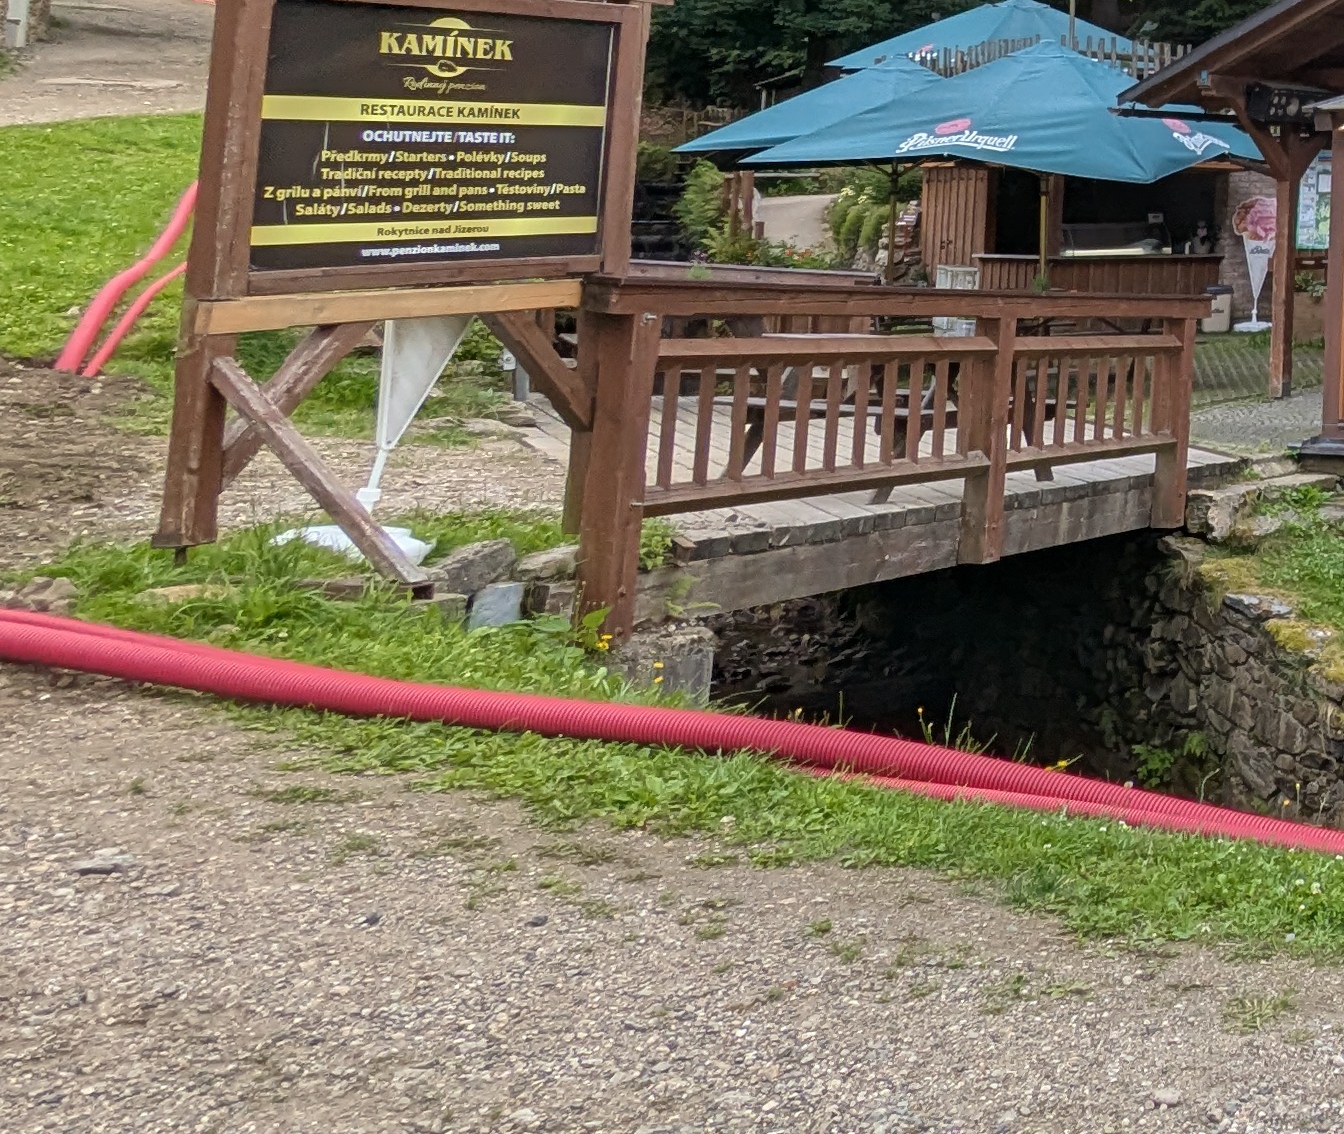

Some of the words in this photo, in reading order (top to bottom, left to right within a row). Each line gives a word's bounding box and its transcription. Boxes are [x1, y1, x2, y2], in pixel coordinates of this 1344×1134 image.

[379, 30, 514, 61] KAMÍNEK
[360, 104, 454, 118] RESTAURACE
[457, 105, 521, 120] KAMÍNEK
[499, 132, 517, 145] IT:
[896, 132, 960, 154] Pilsner
[959, 130, 1019, 152] Urquell
[321, 167, 376, 180] Tradiční
[503, 168, 545, 181] recipes
[263, 186, 275, 199] Z
[276, 186, 310, 202] grilu
[312, 188, 321, 198] a
[404, 183, 431, 199] grill
[433, 184, 457, 196] and
[459, 186, 488, 198] pans
[527, 199, 560, 211] sweet
[377, 226, 429, 239] Rokytnice
[431, 225, 451, 235] nad
[453, 224, 489, 235] Jizerou
[361, 242, 500, 258] www.penzionkaminek.com
